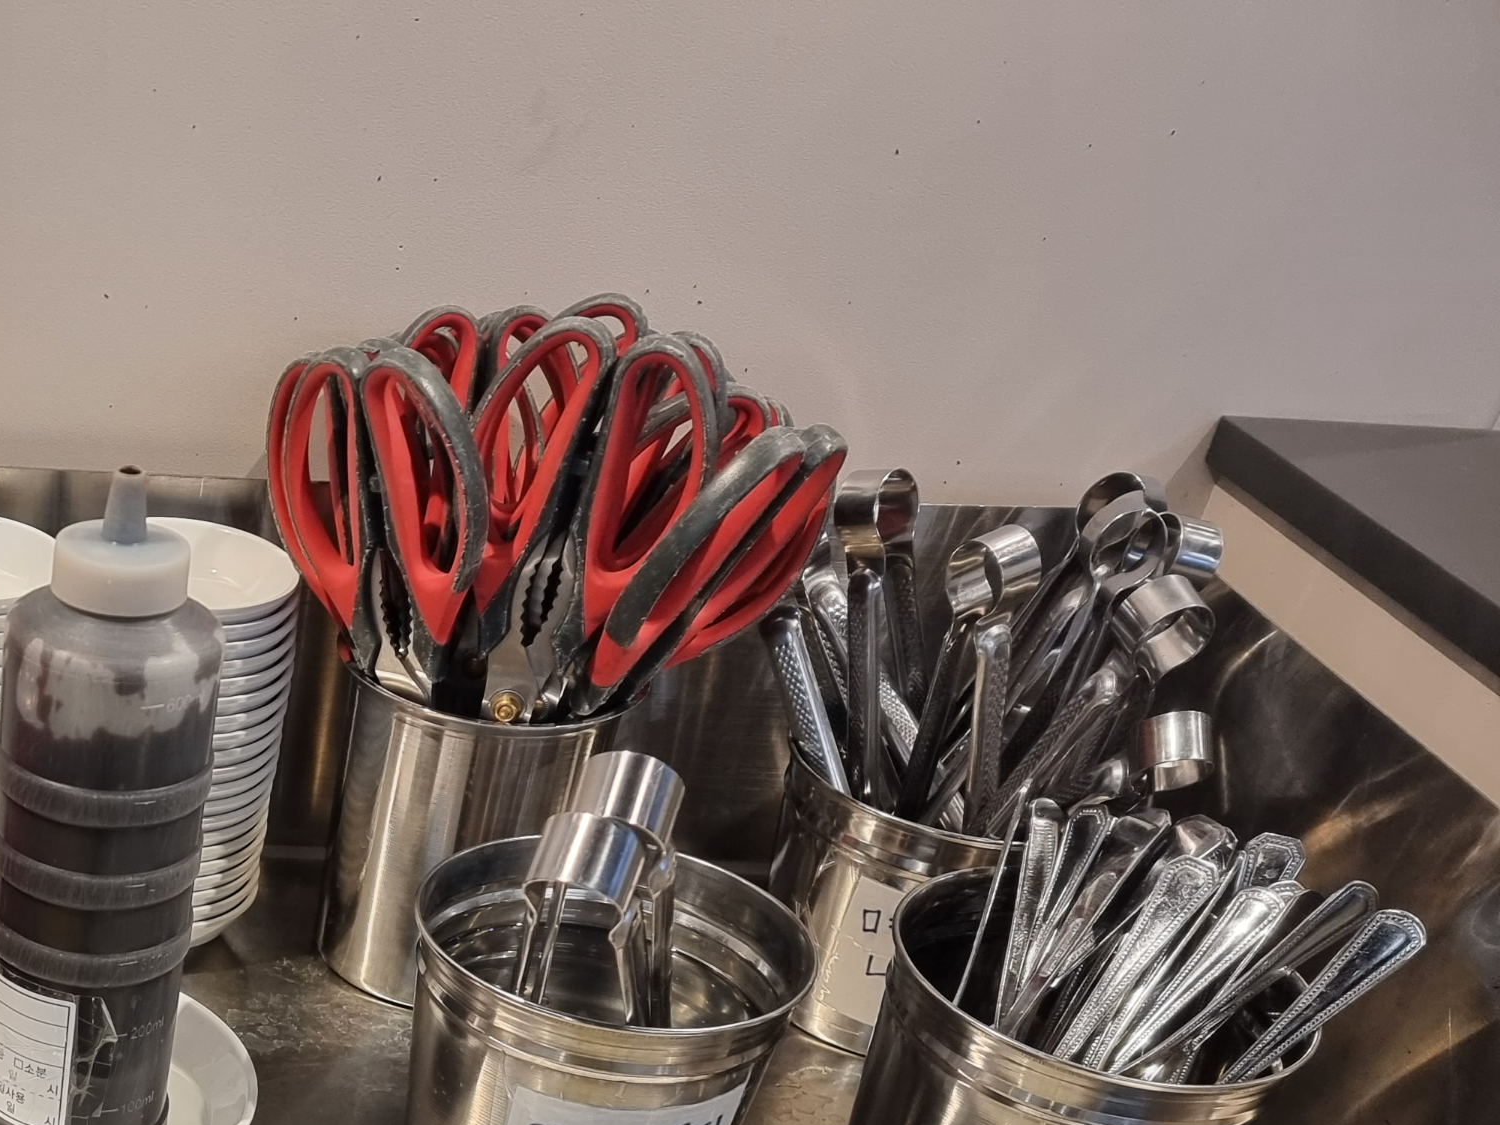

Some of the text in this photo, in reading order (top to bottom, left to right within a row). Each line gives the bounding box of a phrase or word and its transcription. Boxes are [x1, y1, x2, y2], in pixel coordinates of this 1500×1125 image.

[130, 1016, 165, 1041] 200ml
[23, 1063, 47, 1079] 소분
[46, 1084, 59, 1096] 시
[120, 1090, 155, 1115] 100ml
